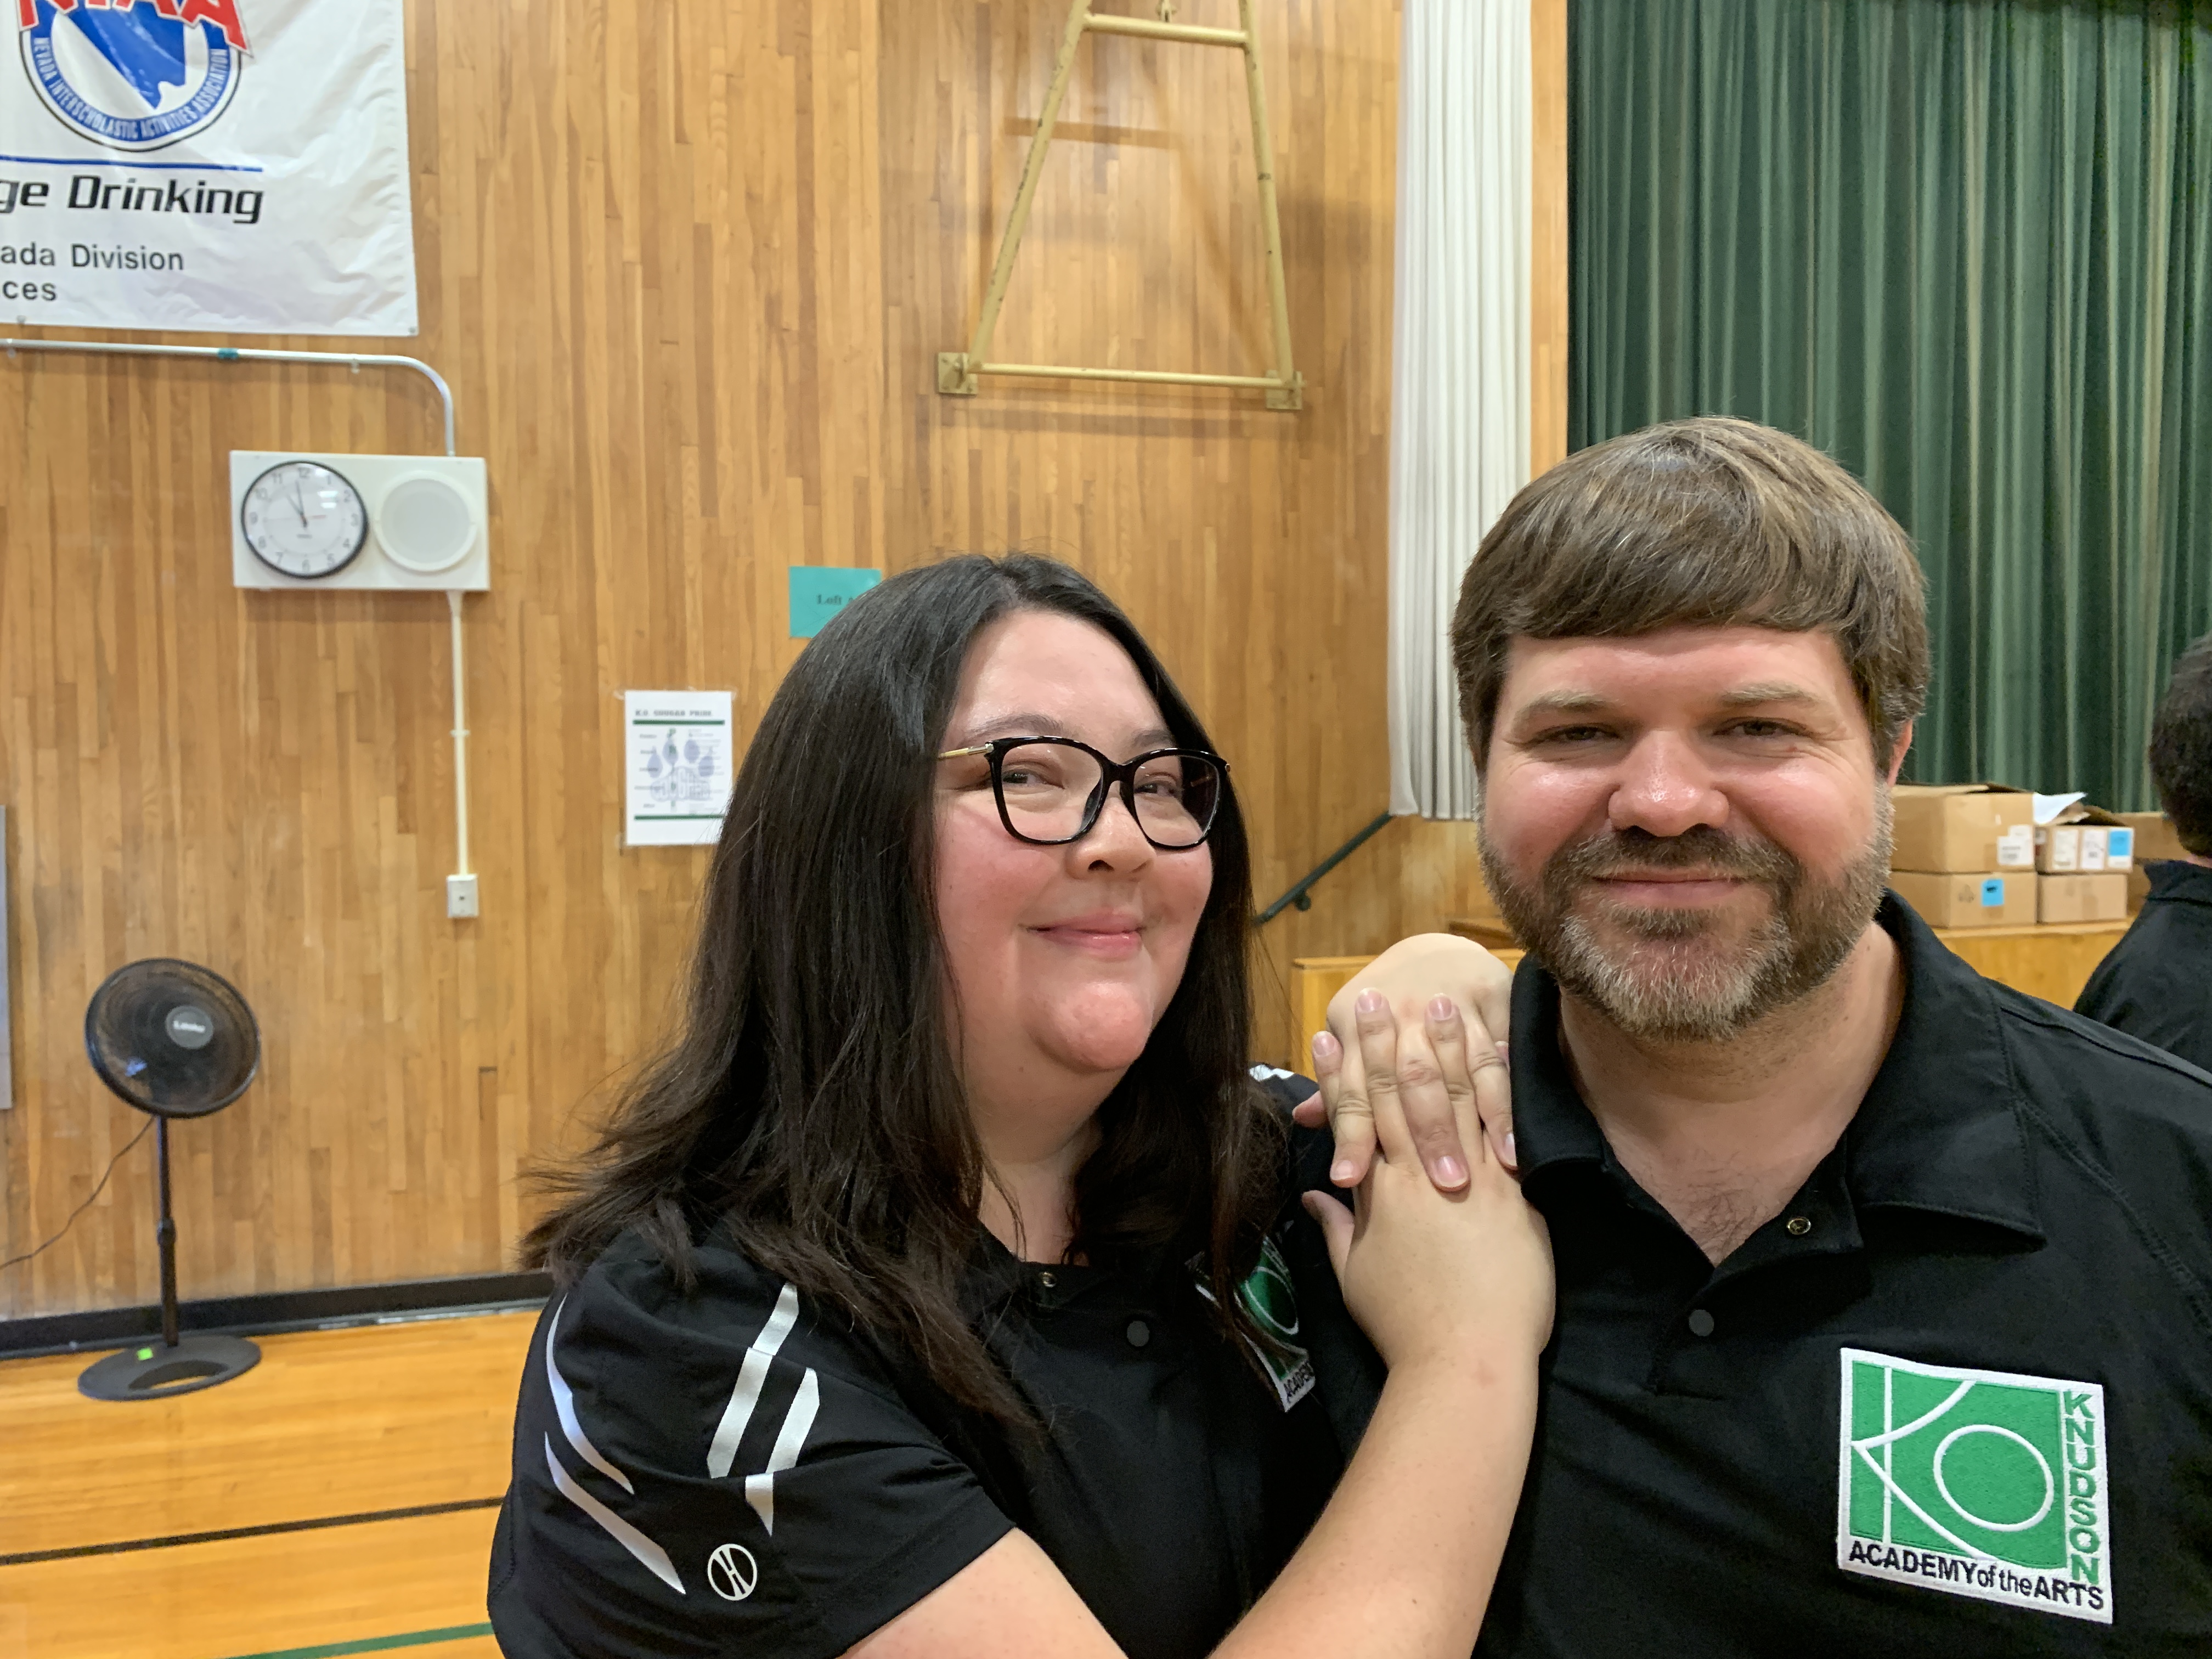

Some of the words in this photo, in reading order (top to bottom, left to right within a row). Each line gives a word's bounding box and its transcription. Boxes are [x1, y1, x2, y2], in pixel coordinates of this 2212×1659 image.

[33, 37, 58, 81] NEVADA
[67, 174, 264, 225] Drinking
[71, 243, 185, 270] Division
[2, 280, 58, 302] ces
[2063, 1389, 2102, 1585] KNUDSON
[1848, 1540, 1978, 1584] ACADEMY
[2034, 1576, 2104, 1611] ARTS
